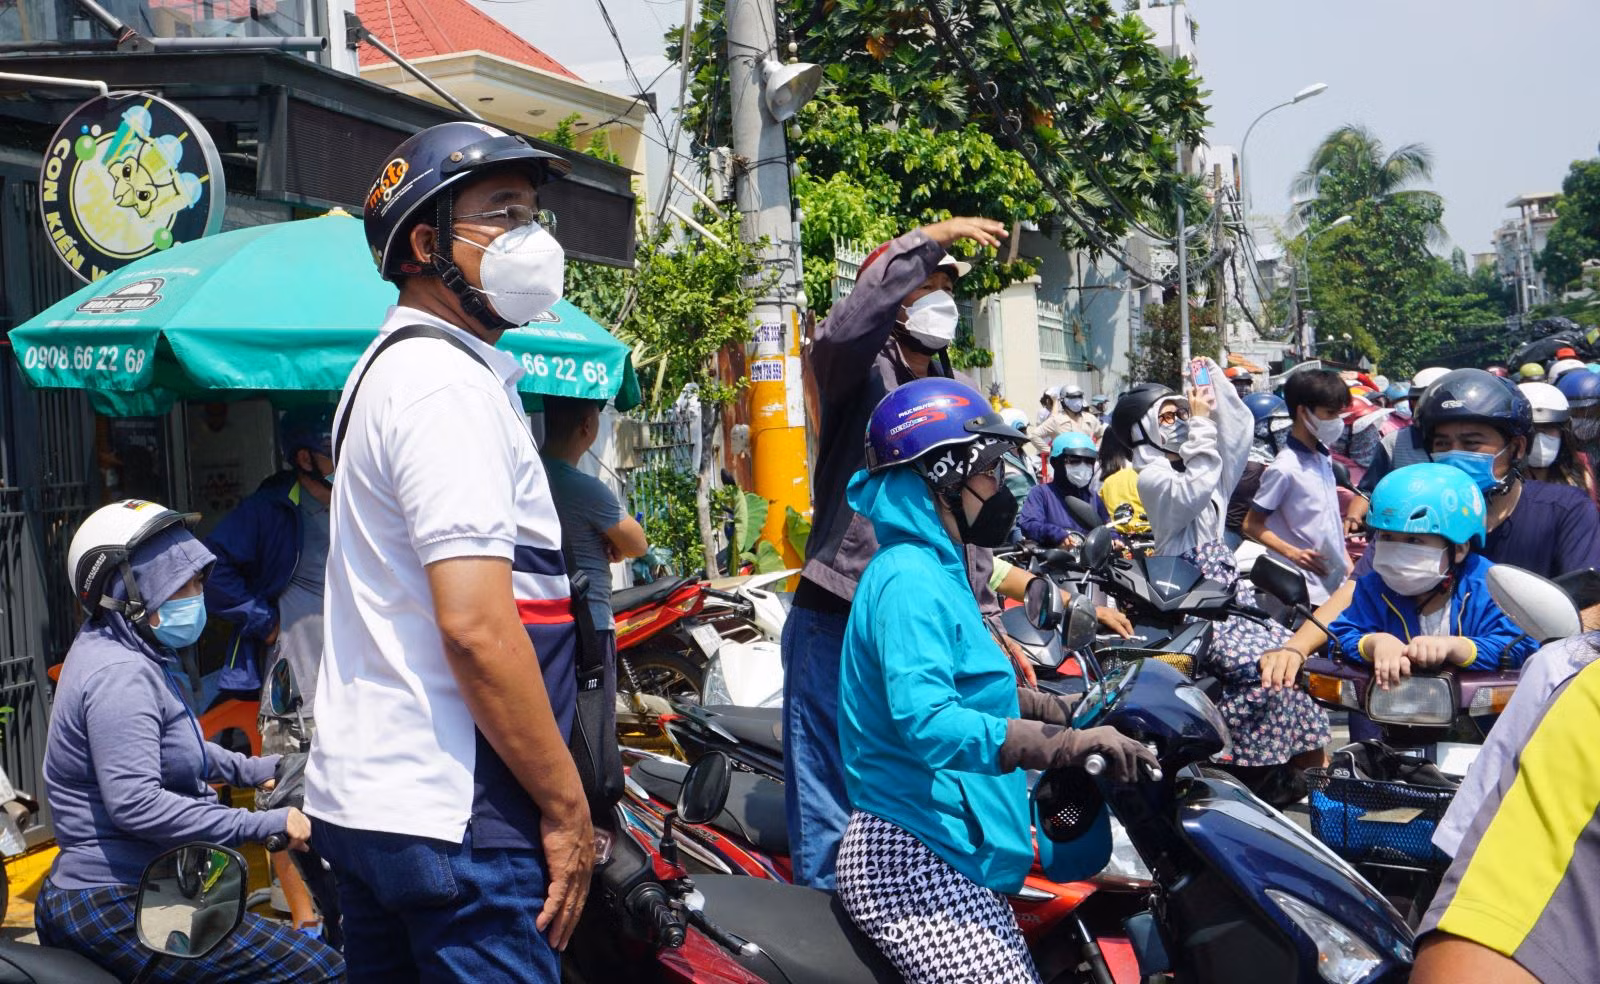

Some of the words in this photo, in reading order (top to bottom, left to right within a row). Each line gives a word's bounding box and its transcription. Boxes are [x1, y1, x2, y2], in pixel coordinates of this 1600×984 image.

[43, 138, 71, 202] CON
[24, 345, 93, 370] 0908.66
[96, 345, 118, 371] 22
[124, 348, 146, 374] 68
[521, 352, 549, 377] 66
[552, 356, 577, 382] 22
[582, 361, 609, 385] 68
